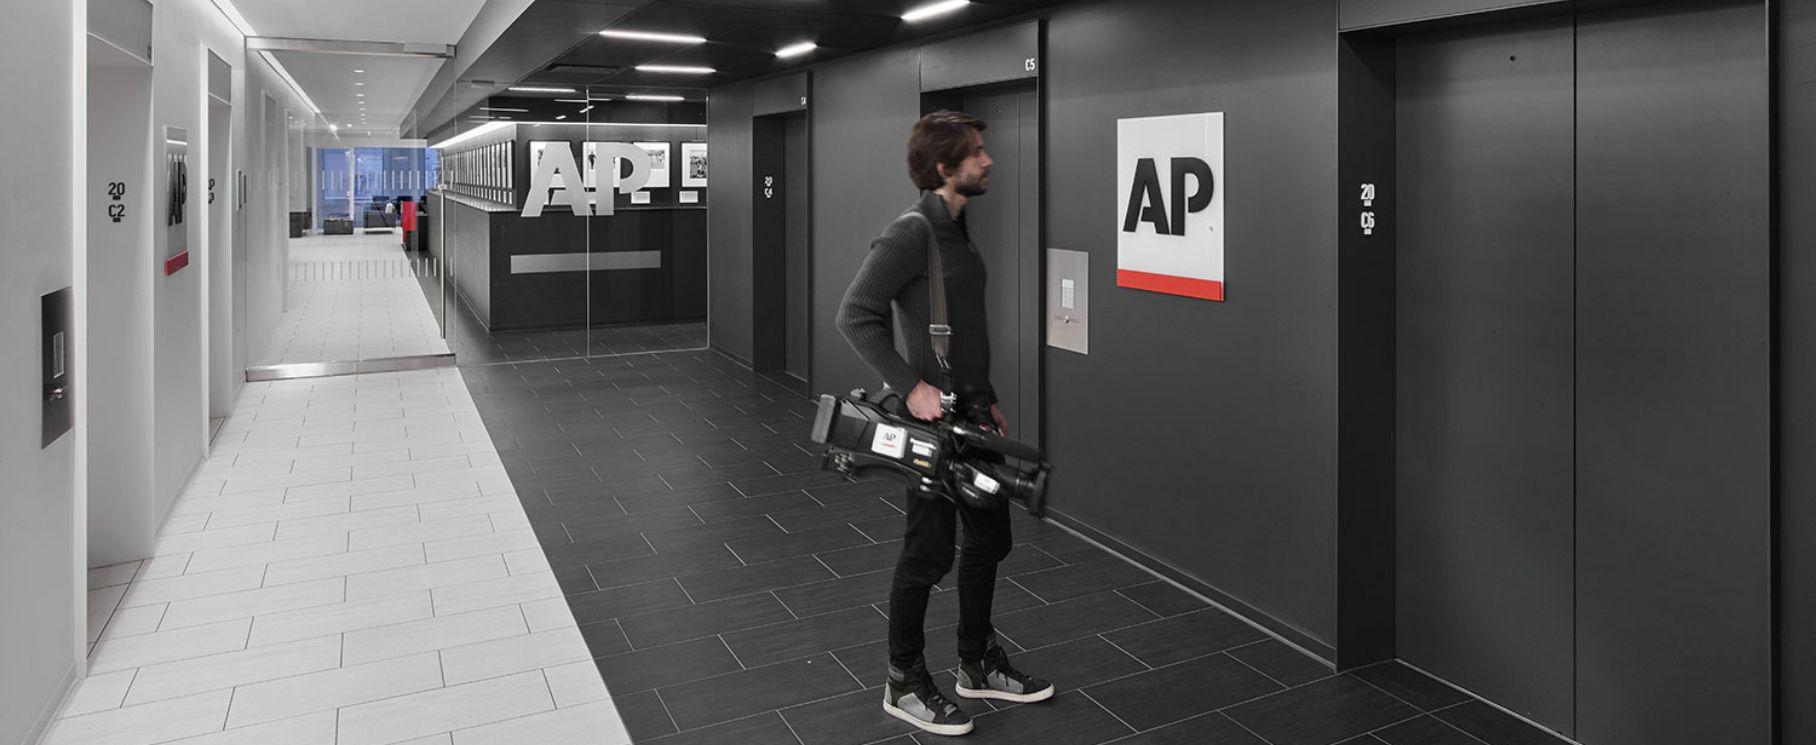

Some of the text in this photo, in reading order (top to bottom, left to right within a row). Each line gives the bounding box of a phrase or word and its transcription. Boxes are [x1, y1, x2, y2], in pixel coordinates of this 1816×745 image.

[1025, 58, 1036, 71] C5
[521, 142, 652, 217] AP
[108, 182, 126, 196] 20
[1123, 157, 1214, 236] AP
[1360, 183, 1375, 200] 20
[108, 204, 126, 218] C2
[1360, 211, 1375, 228] C6
